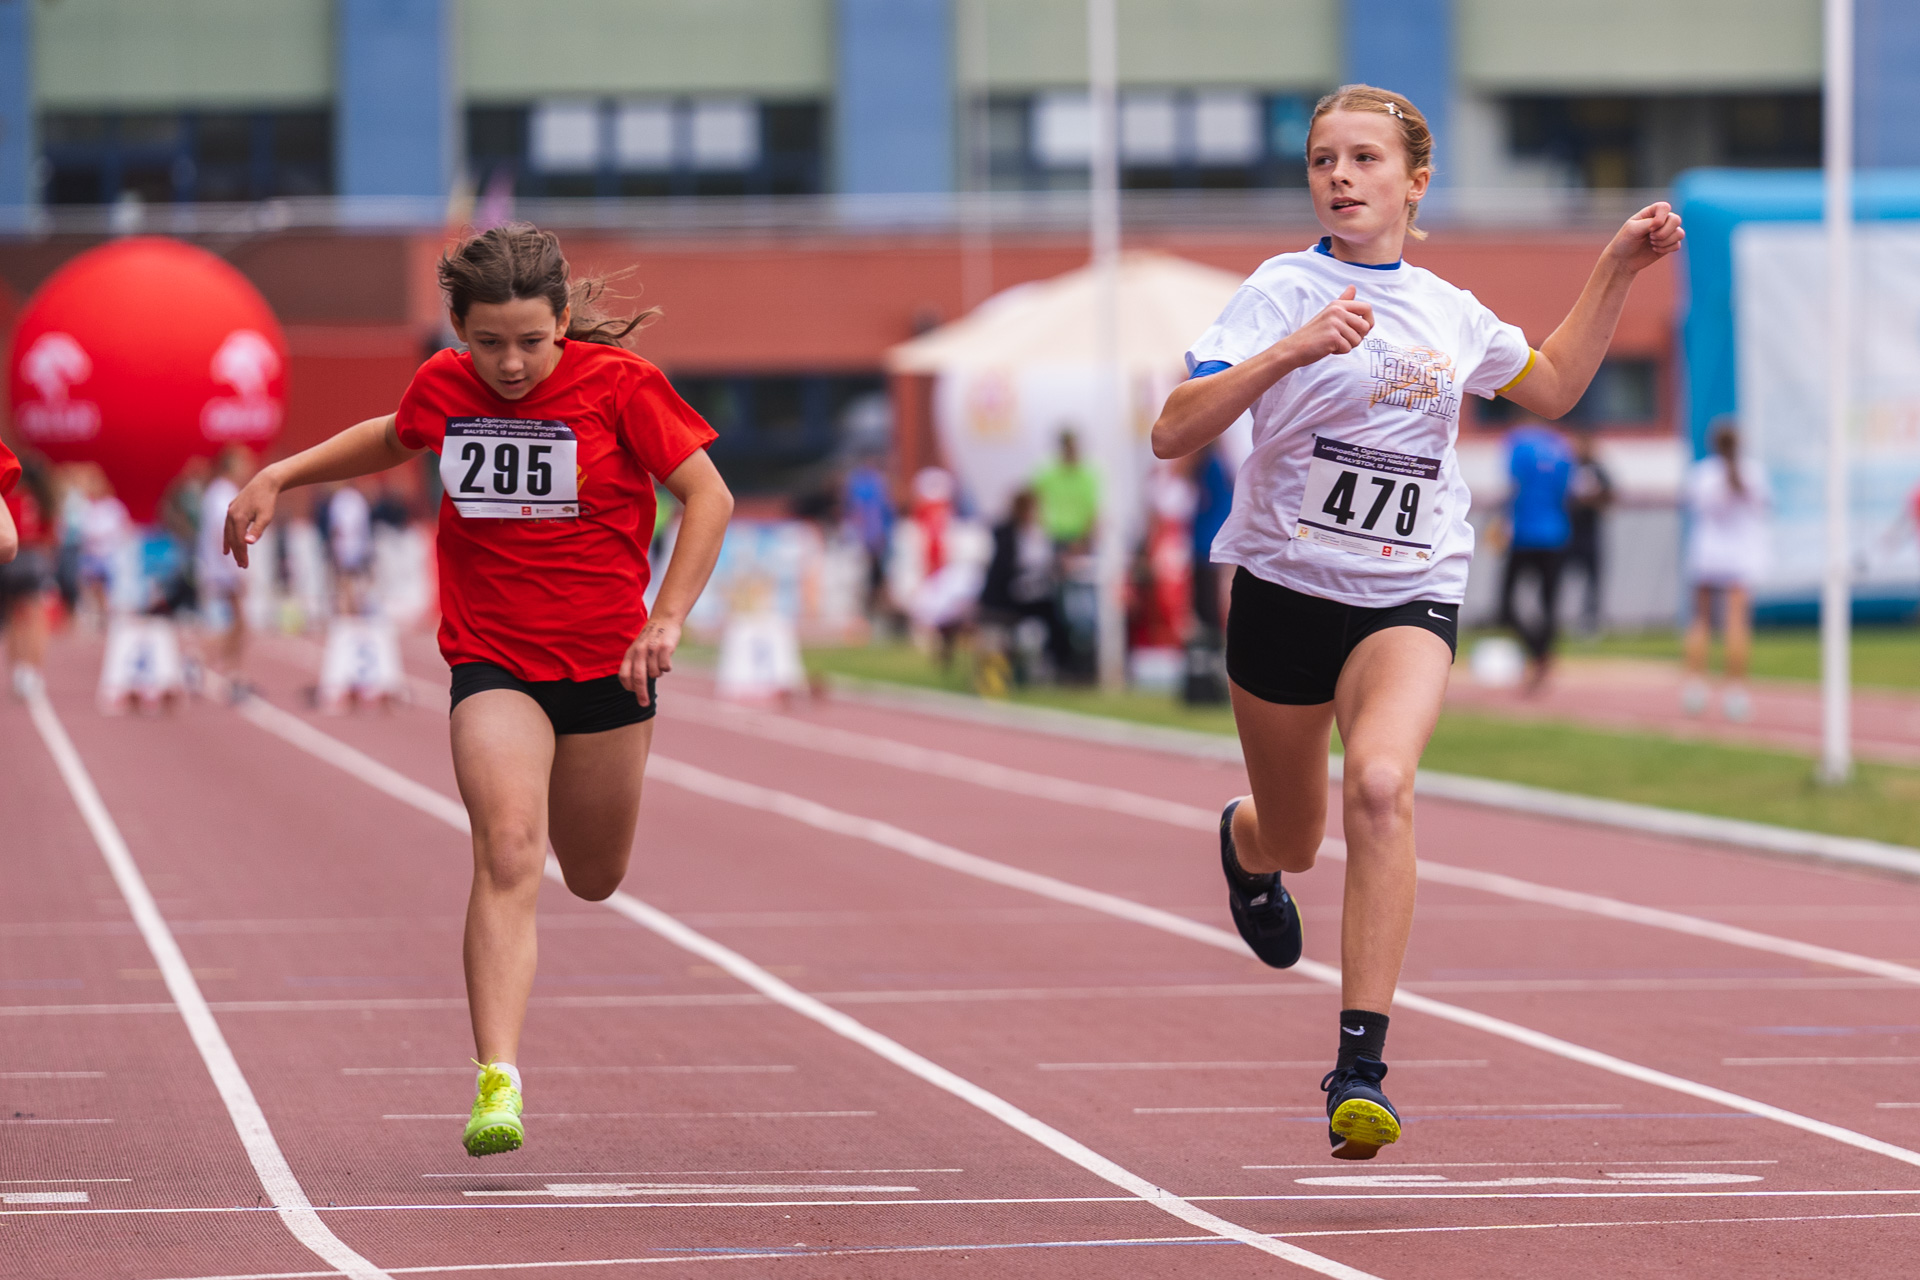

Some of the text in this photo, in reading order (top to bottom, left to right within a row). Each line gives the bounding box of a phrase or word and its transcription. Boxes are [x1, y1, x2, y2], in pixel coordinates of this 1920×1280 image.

[1370, 350, 1452, 391] Nadzieje
[1373, 380, 1457, 418] Olimpijskie
[460, 442, 552, 496] 295
[1322, 471, 1420, 536] 479
